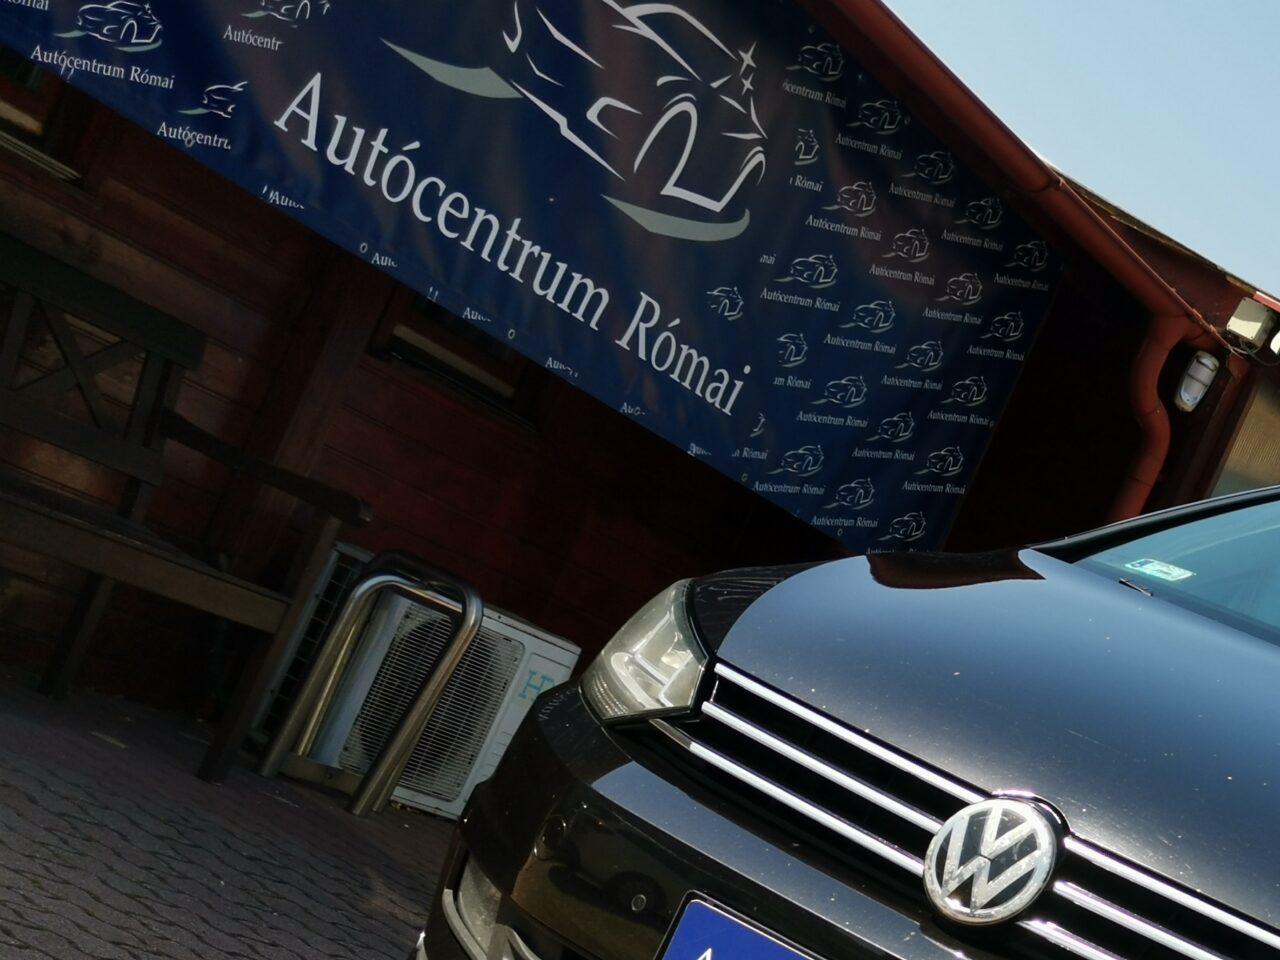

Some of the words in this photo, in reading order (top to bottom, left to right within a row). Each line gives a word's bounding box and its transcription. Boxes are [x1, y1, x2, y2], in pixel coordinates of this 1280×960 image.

[30, 44, 125, 79] Autócentrum
[129, 65, 175, 89] Római
[795, 174, 824, 192] Római
[273, 72, 611, 332] Autócentrum
[614, 291, 752, 416] Római
[805, 213, 859, 237] Autócentrum
[859, 225, 882, 242] Római
